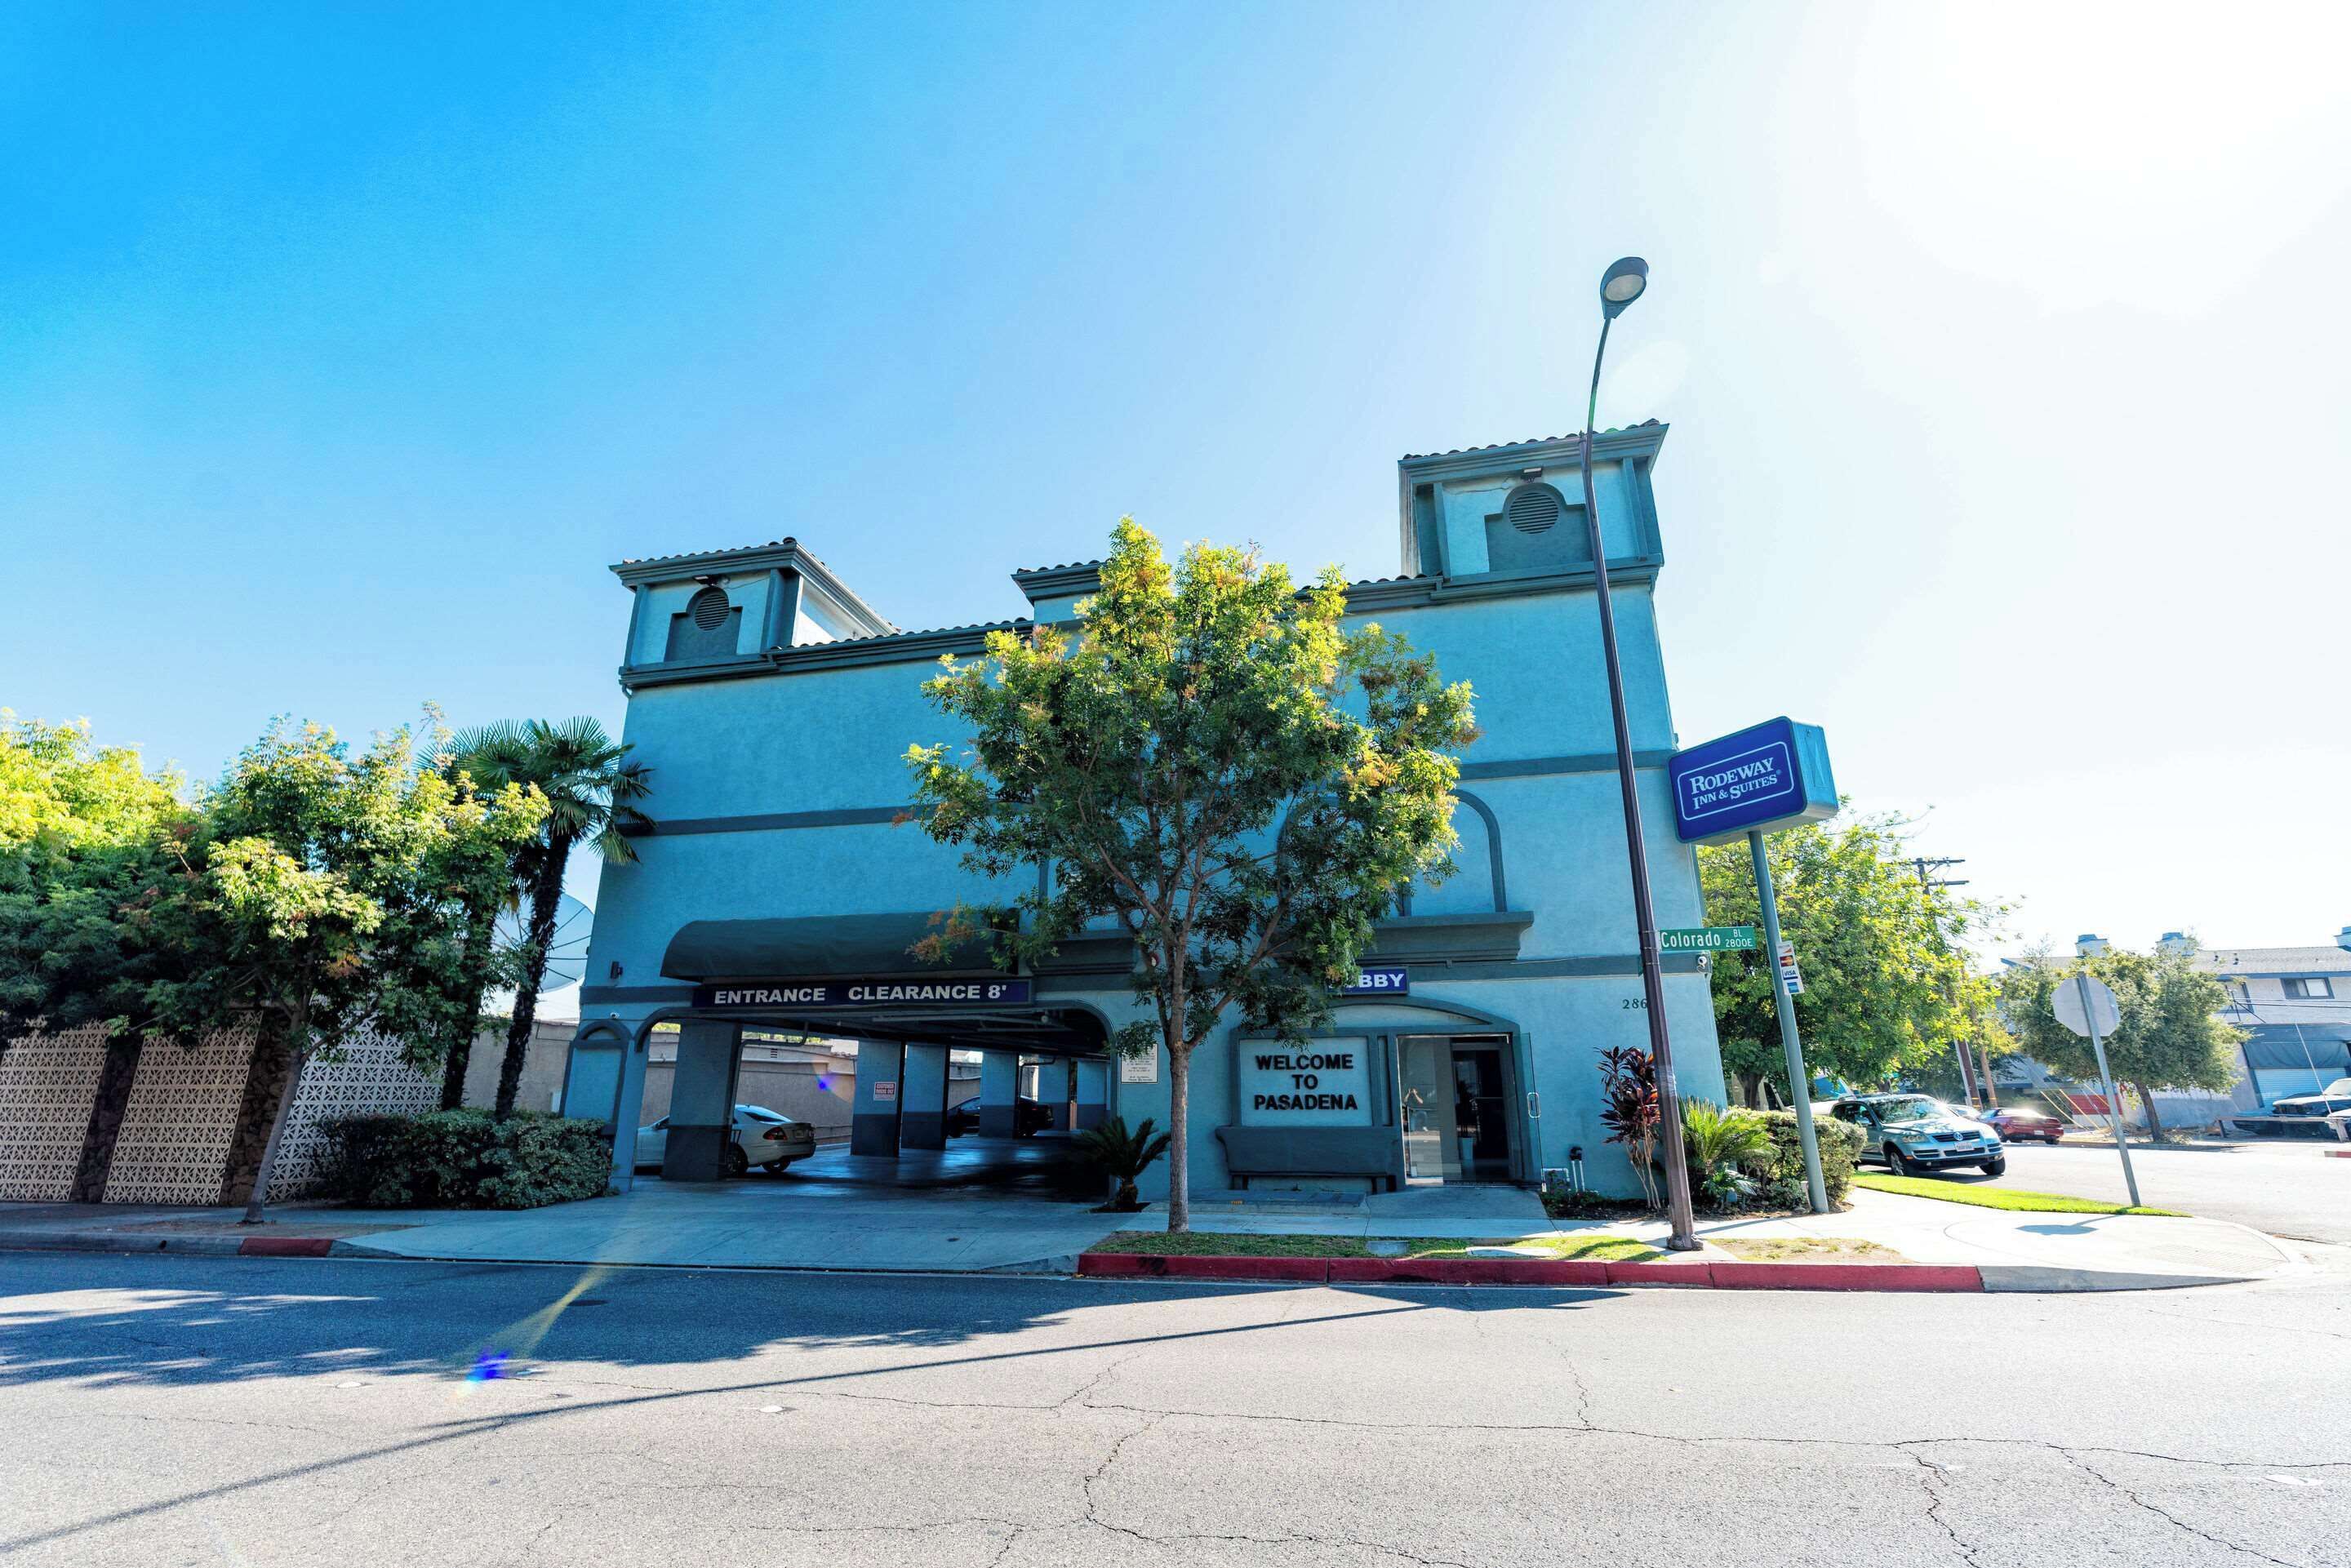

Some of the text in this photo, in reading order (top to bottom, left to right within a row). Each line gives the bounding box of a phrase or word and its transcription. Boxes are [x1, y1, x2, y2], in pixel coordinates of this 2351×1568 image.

[1690, 757, 1774, 794] RODEWAY
[1693, 775, 1778, 810] INN & SUITES
[1660, 929, 1743, 948] Colorado BL
[1725, 938, 1753, 948] 2800E
[1329, 973, 1405, 988] BBY
[714, 984, 1007, 1004] ENTRANCE CLEARANCE 8'
[1255, 1054, 1353, 1070] WELCOME
[1291, 1074, 1318, 1090] TO
[1254, 1095, 1358, 1111] PASADENA
